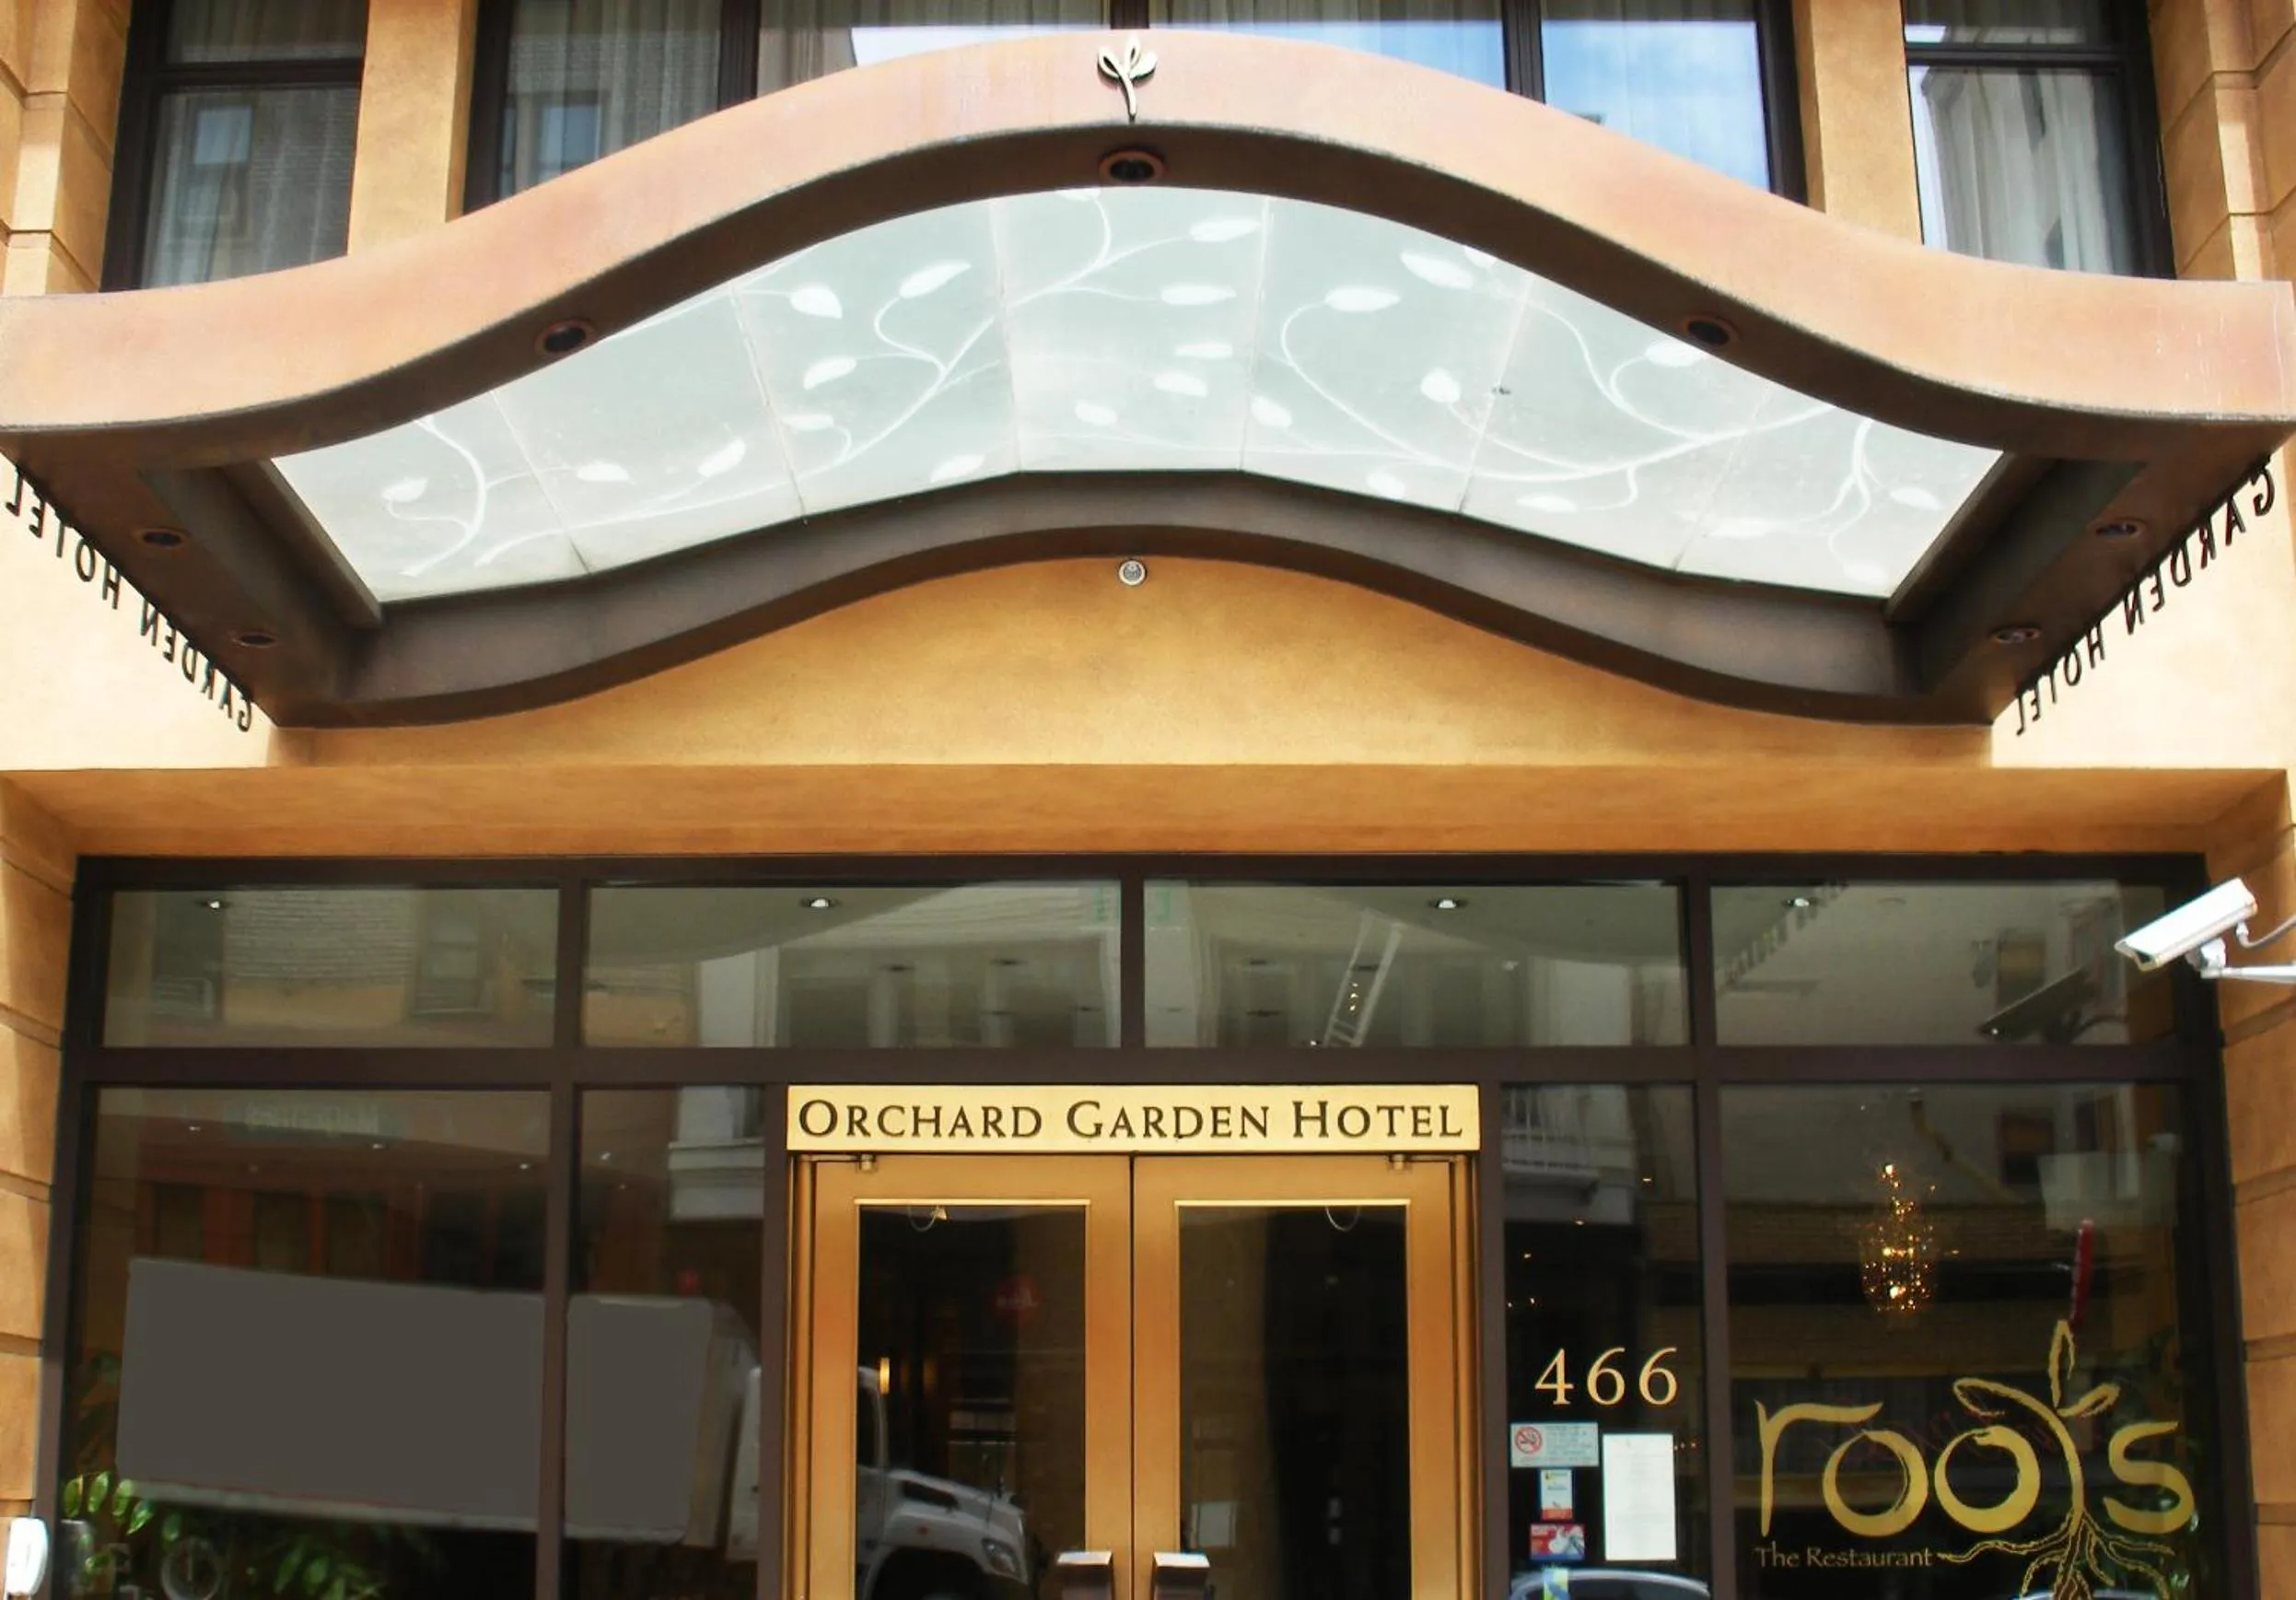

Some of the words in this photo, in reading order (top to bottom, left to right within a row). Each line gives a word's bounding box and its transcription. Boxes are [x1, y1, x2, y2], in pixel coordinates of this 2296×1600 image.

[798, 1099, 1043, 1139] ORCHARD
[1066, 1100, 1270, 1140] GARDEN
[1291, 1100, 1463, 1139] HOTEL
[1533, 1347, 1678, 1406] 466
[1753, 1540, 1800, 1568] The
[1807, 1546, 1933, 1568] Restaurant
